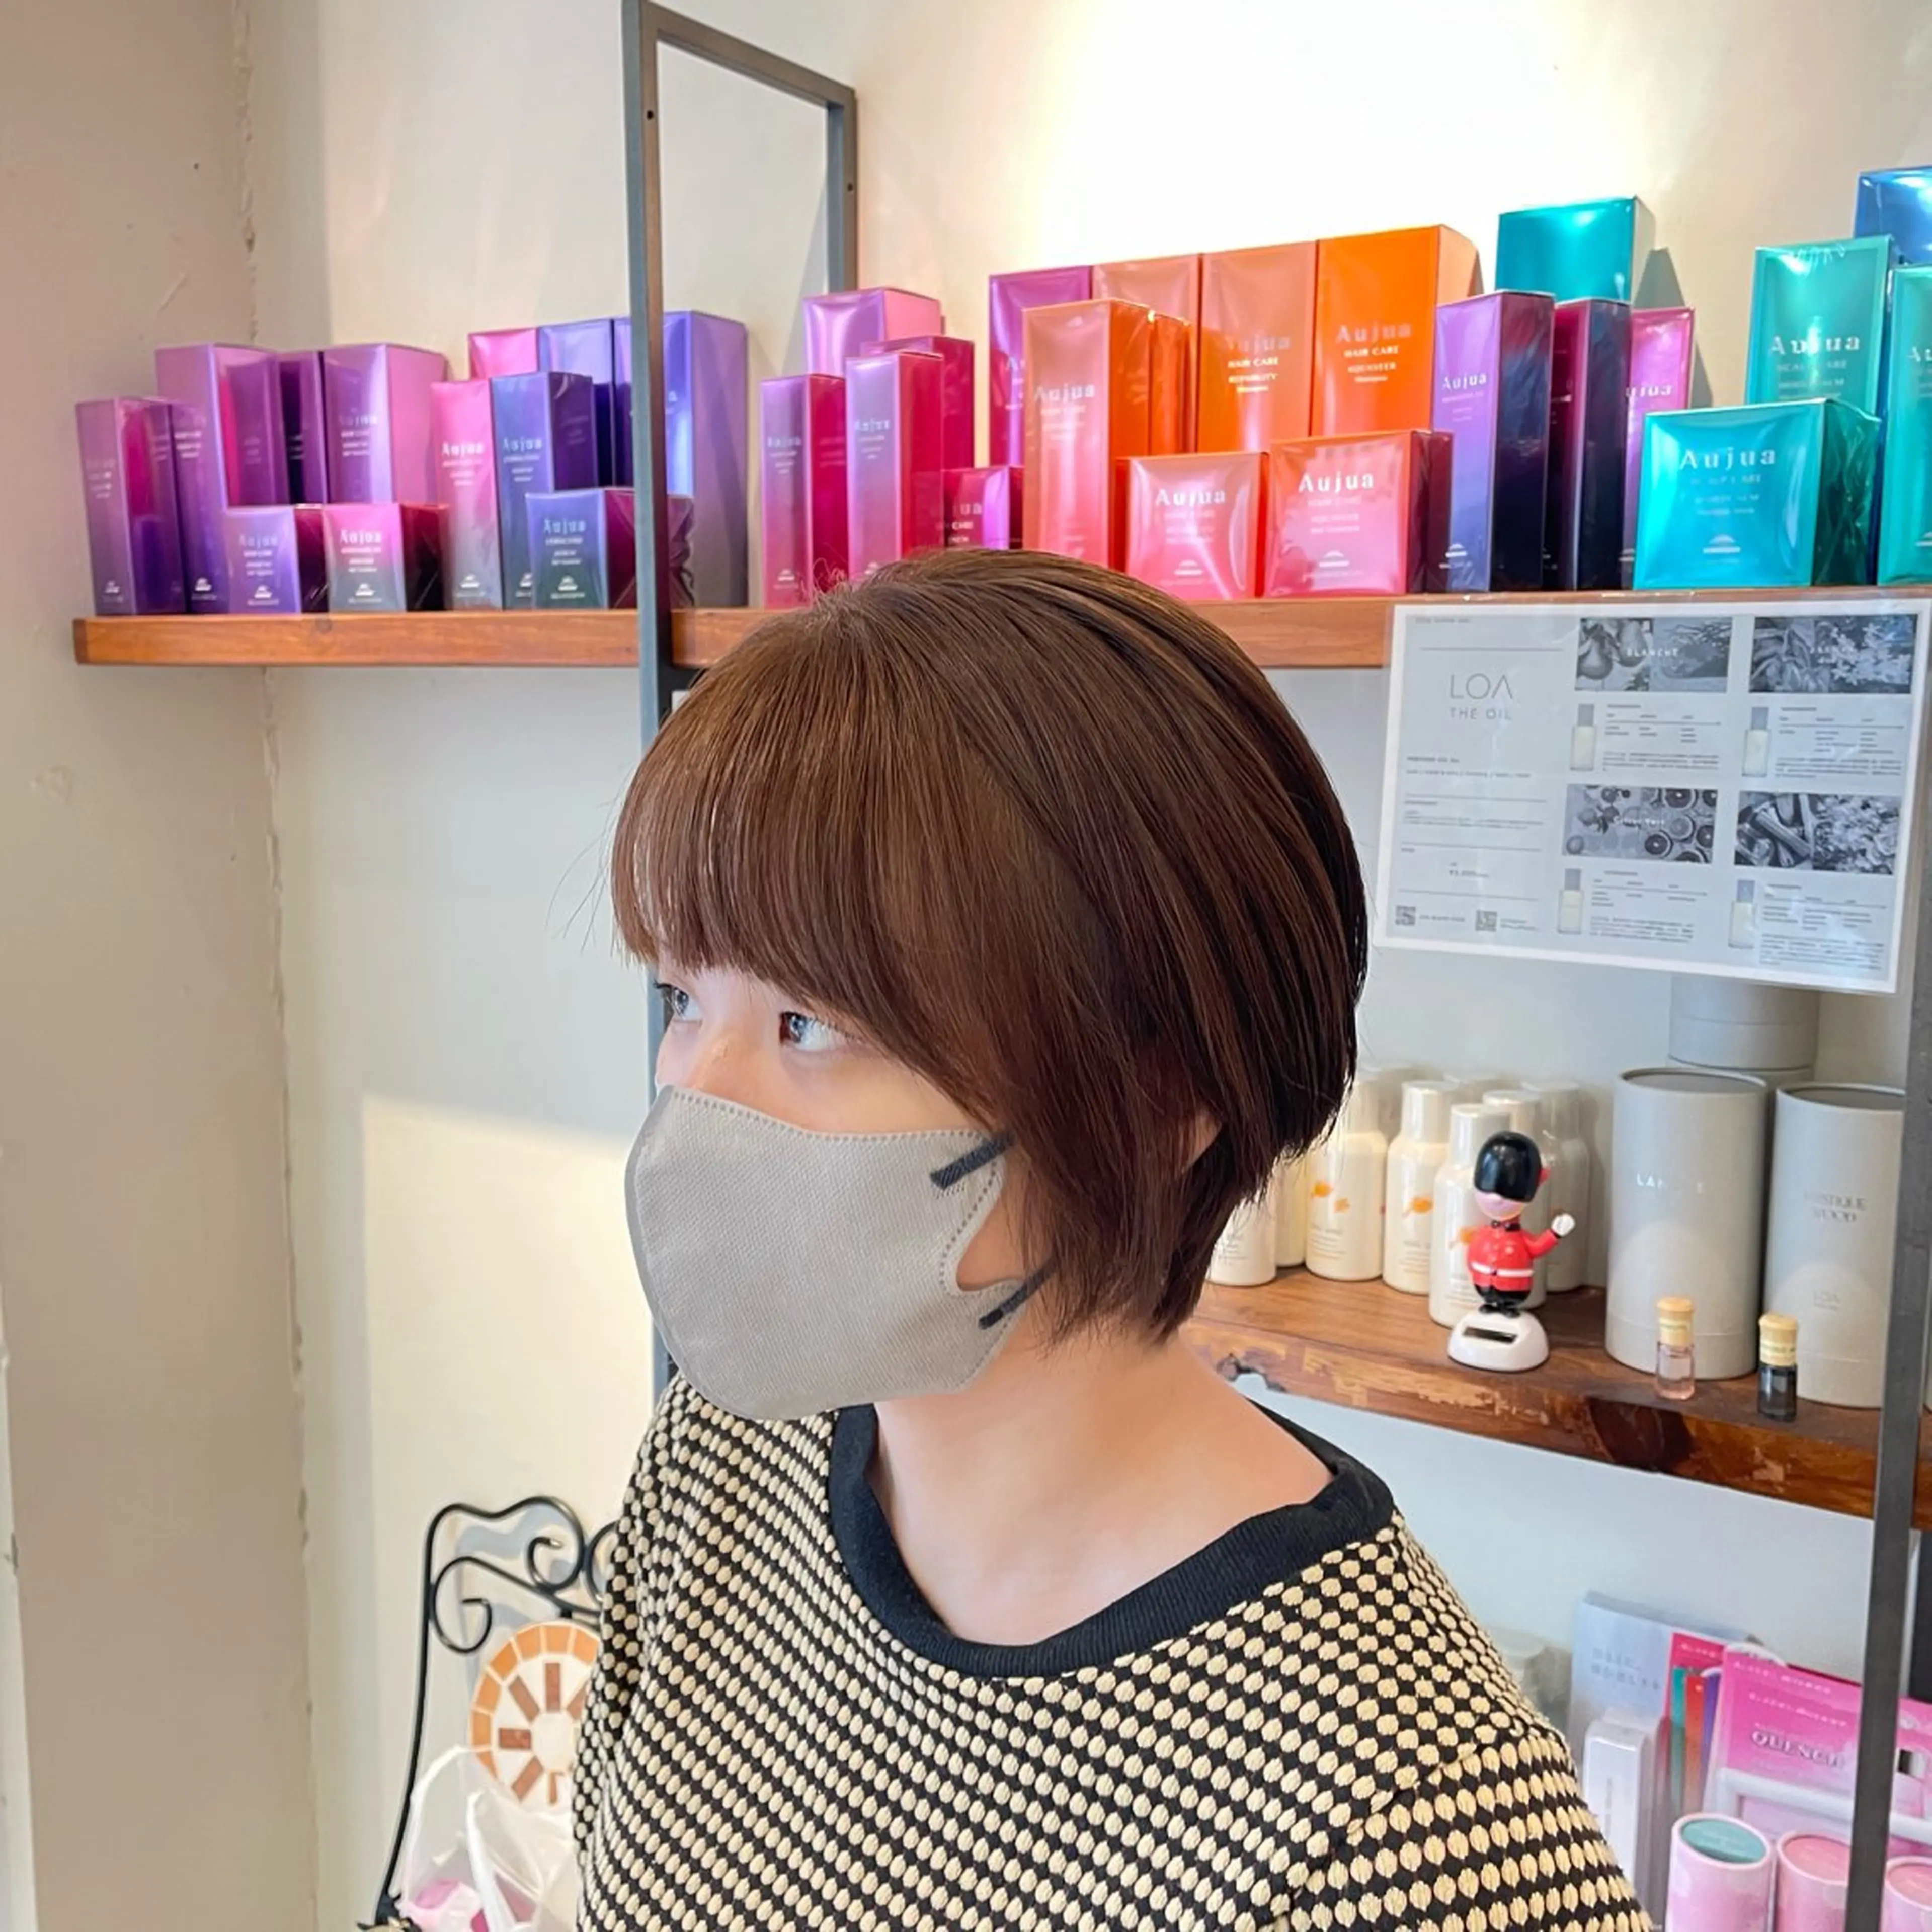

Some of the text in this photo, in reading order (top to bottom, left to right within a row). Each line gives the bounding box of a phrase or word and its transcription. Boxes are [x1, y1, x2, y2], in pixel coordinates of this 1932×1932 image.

[1336, 323, 1411, 344] Aujua
[1769, 335, 1861, 355] Auua
[1678, 446, 1777, 472] Aujua
[1298, 471, 1375, 494] Aujua
[1157, 488, 1226, 508] Aujua
[1450, 672, 1513, 700] LOA
[1450, 707, 1511, 721] THE OIL
